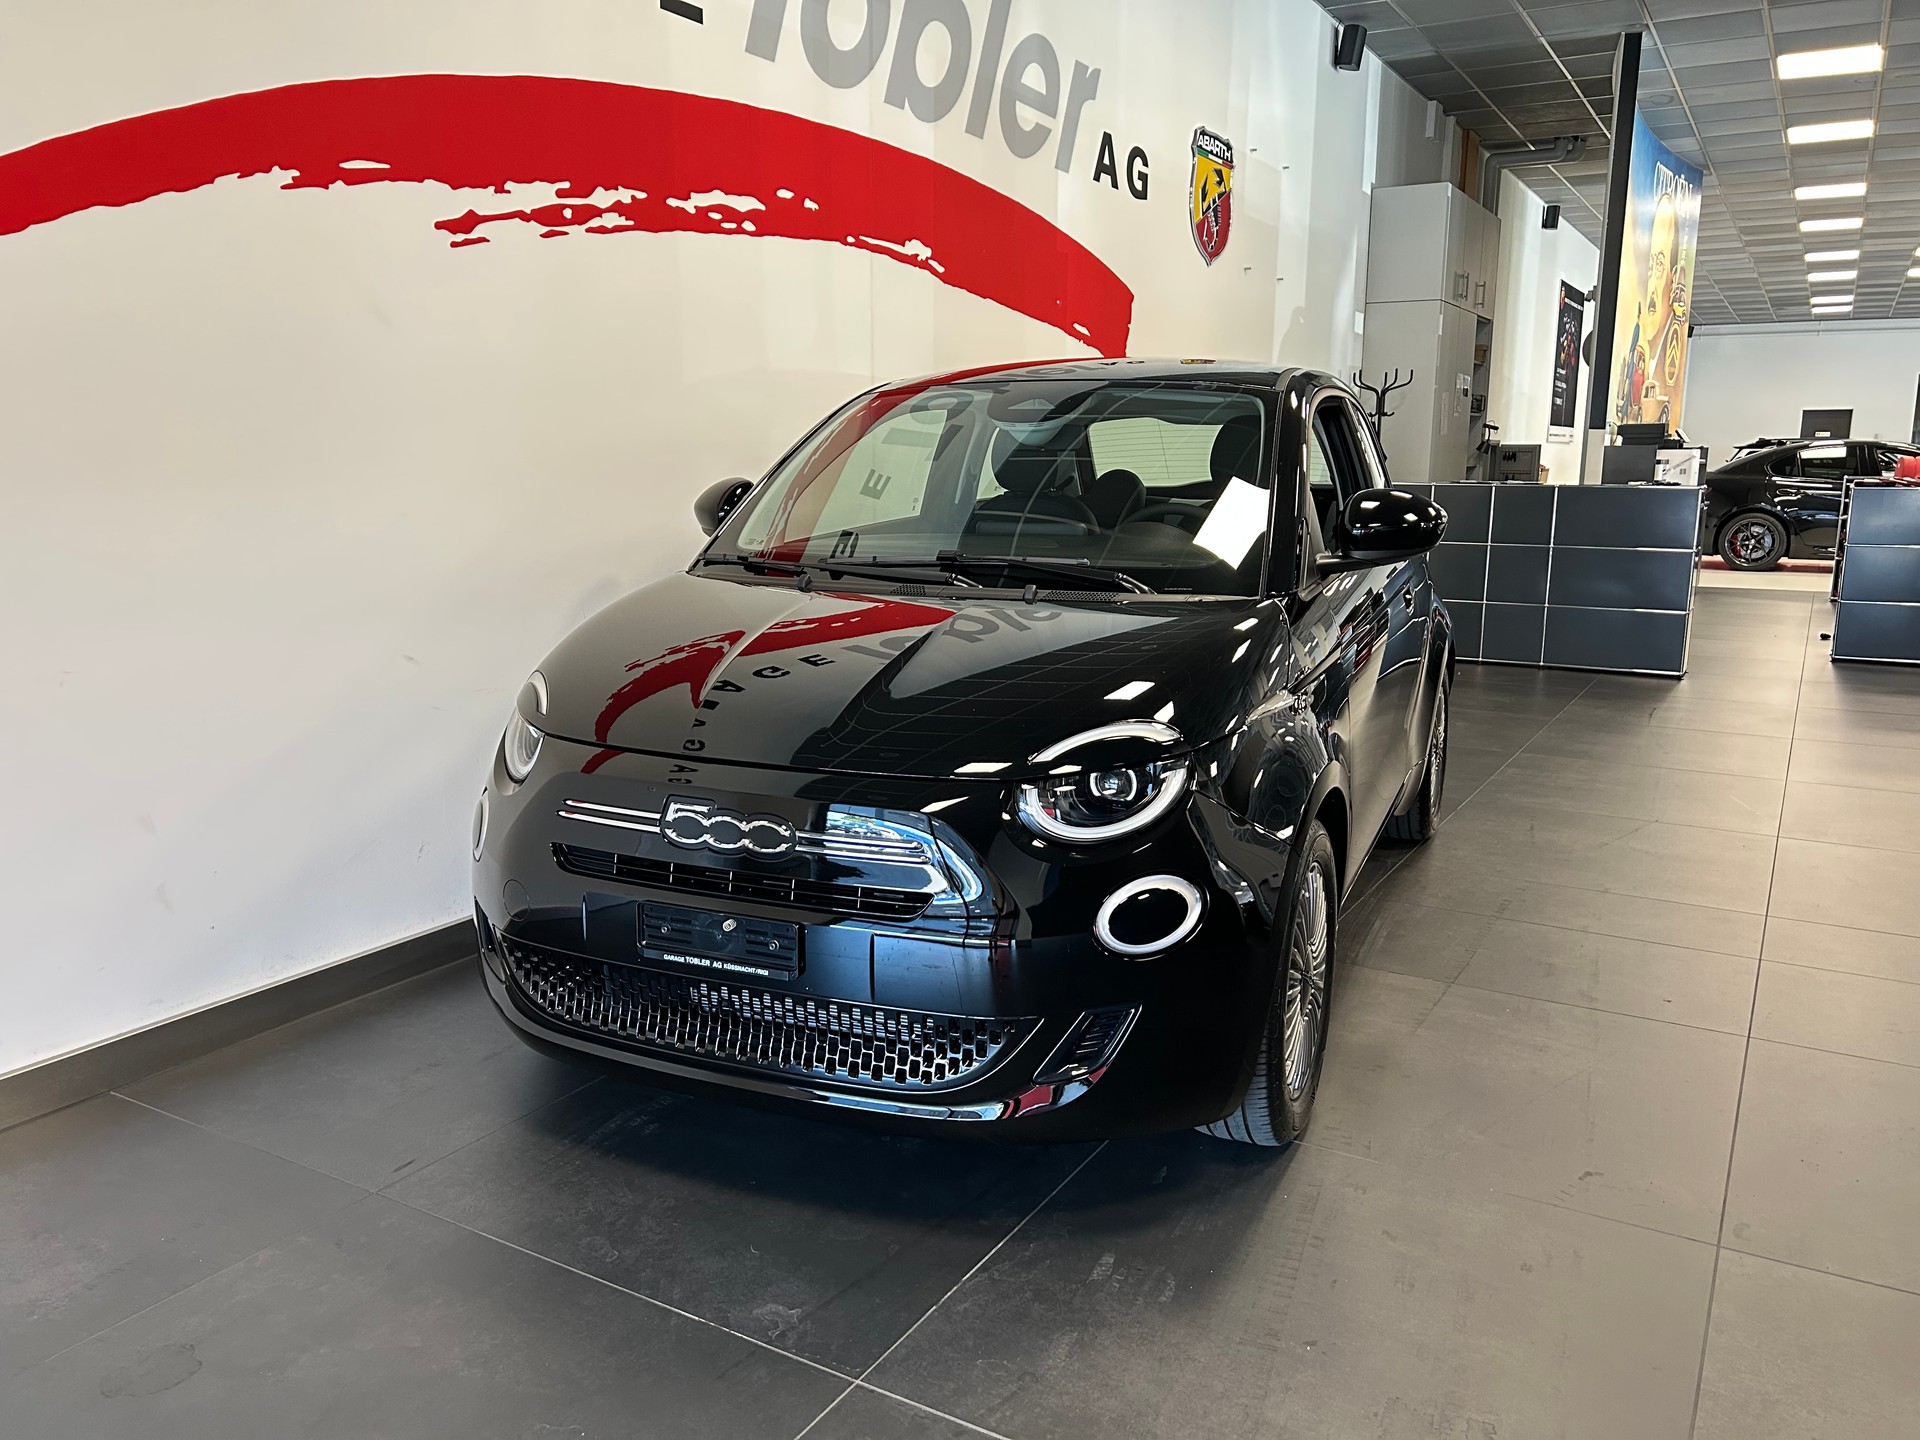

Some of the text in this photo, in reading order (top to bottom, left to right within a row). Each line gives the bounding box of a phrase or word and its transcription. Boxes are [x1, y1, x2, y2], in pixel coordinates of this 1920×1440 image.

[1093, 131, 1149, 201] AG
[1197, 133, 1232, 162] ABARTH
[664, 801, 792, 854] 500
[663, 953, 685, 963] GARAGE
[685, 956, 710, 967] TOBLER
[712, 960, 722, 969] AG
